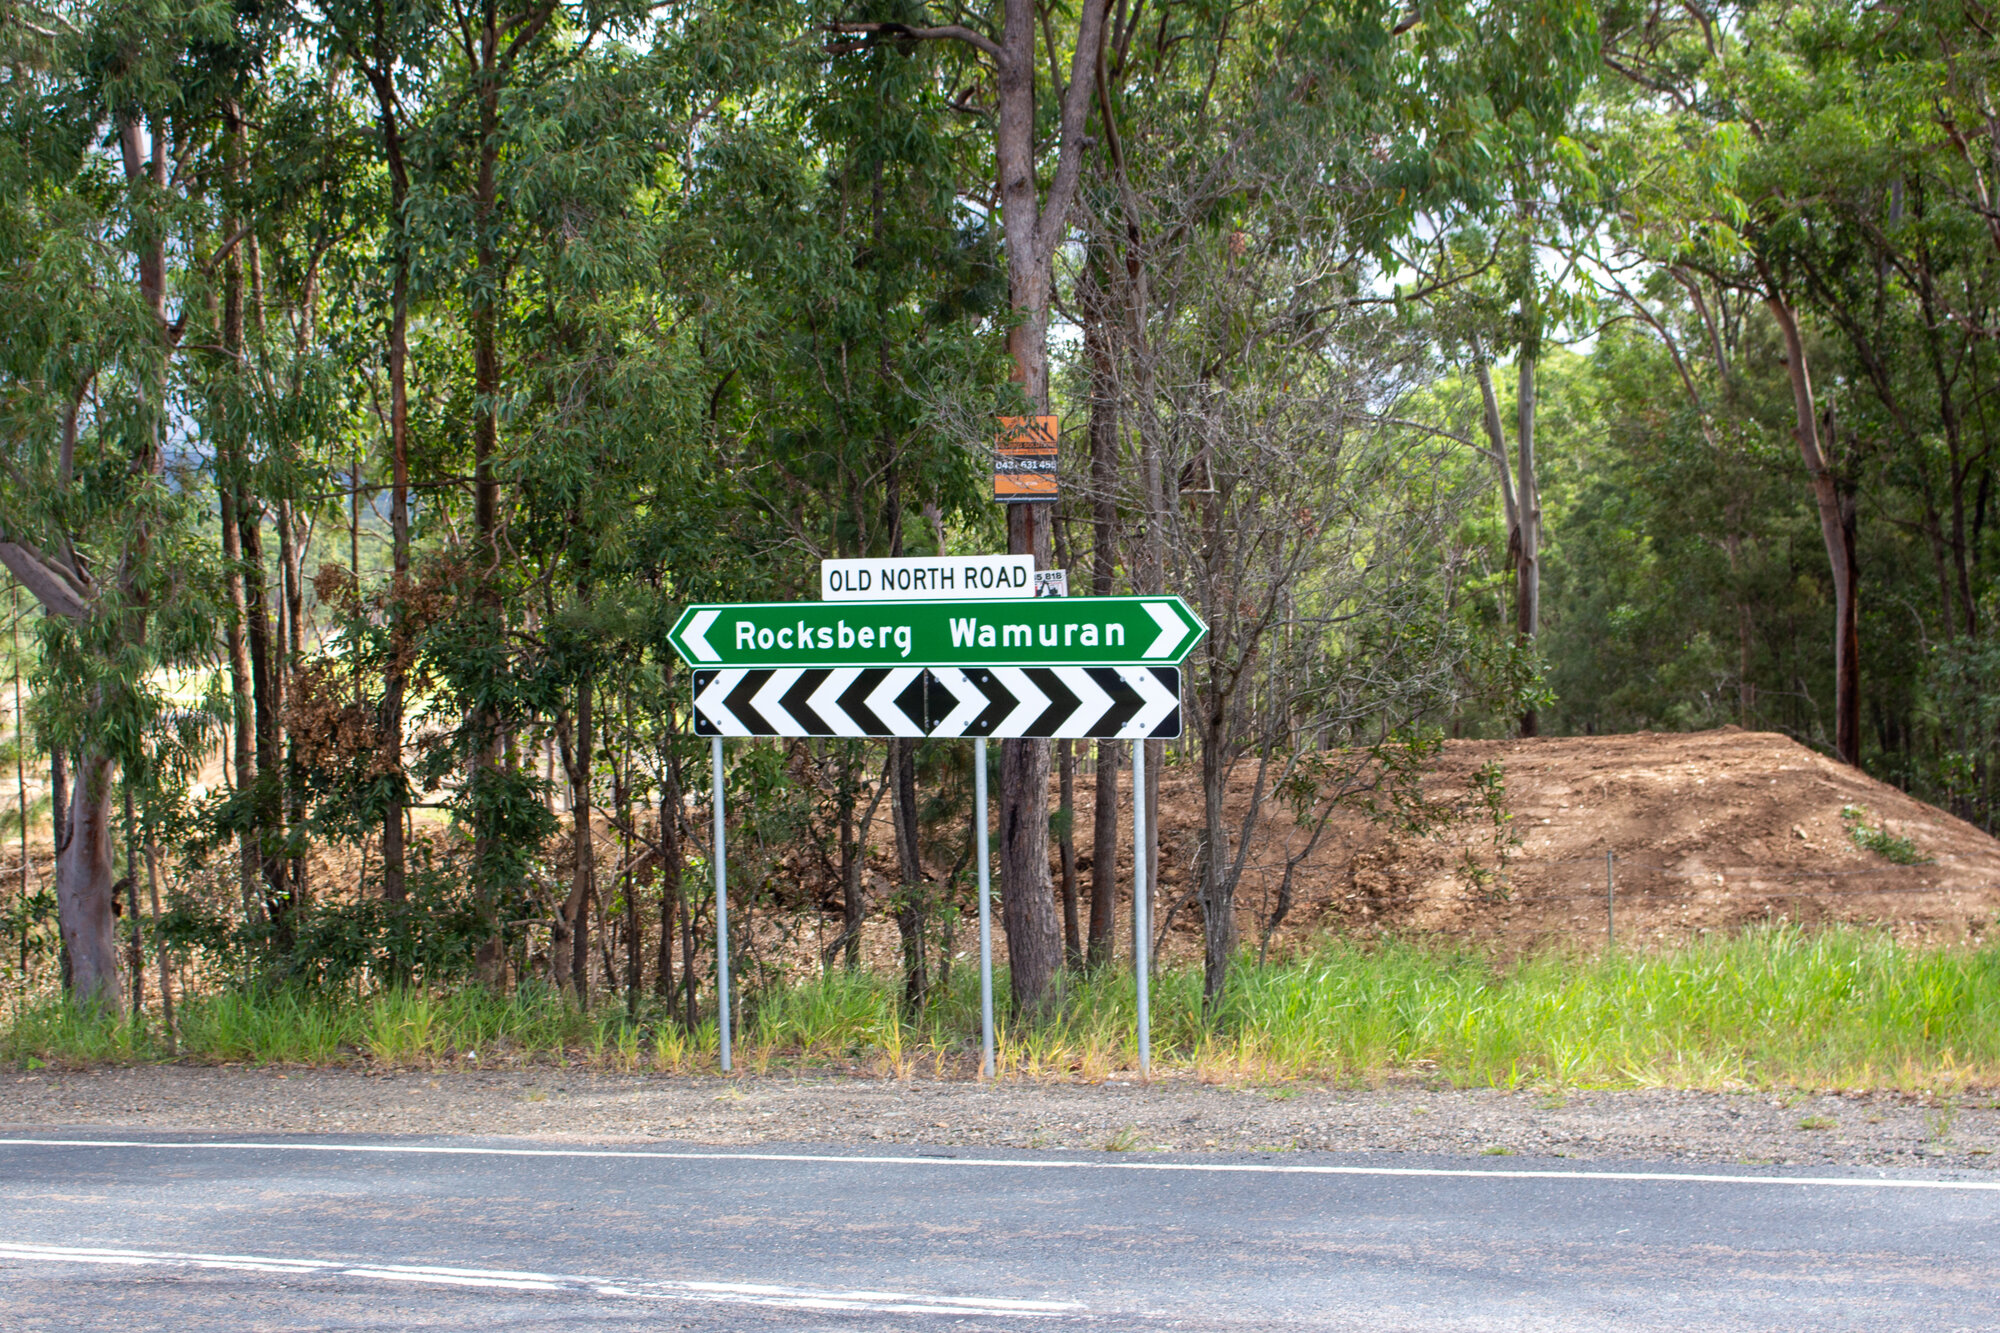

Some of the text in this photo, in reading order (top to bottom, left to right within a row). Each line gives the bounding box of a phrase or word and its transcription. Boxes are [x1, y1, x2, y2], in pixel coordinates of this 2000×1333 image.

[1020, 460, 1038, 470] 631
[829, 565, 1028, 592] OLD NORTH ROAD
[1044, 572, 1062, 580] 818
[735, 620, 912, 658] Rocksberg
[949, 617, 1126, 648] Wamuran
